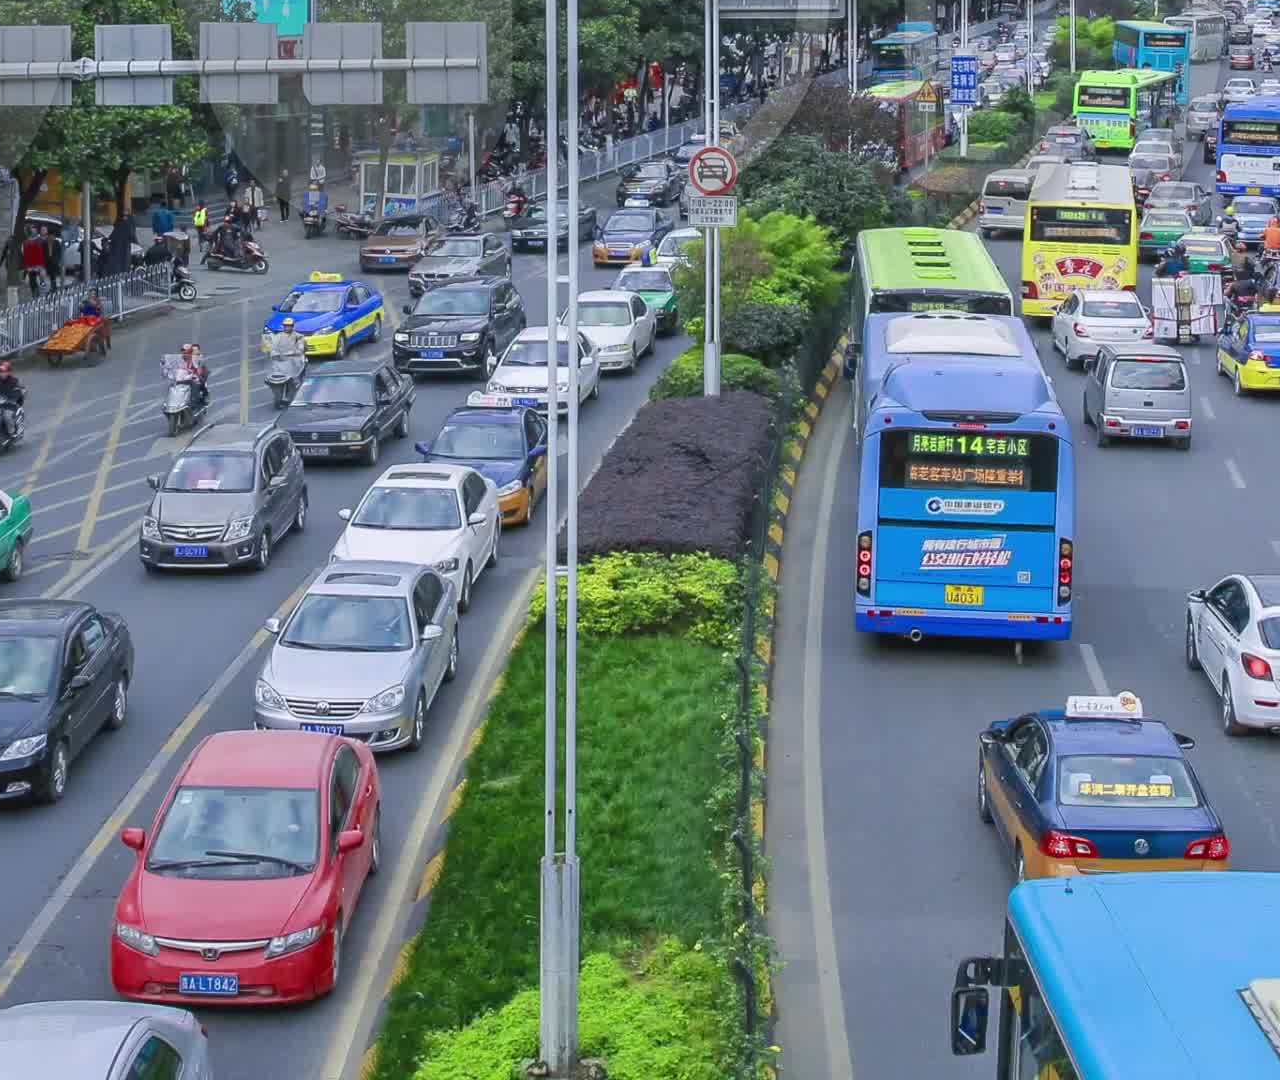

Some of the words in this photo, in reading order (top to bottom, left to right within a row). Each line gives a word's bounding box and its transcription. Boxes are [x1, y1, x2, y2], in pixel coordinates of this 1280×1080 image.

[957, 435, 985, 455] 14
[986, 437, 1031, 458] 宅吉小区
